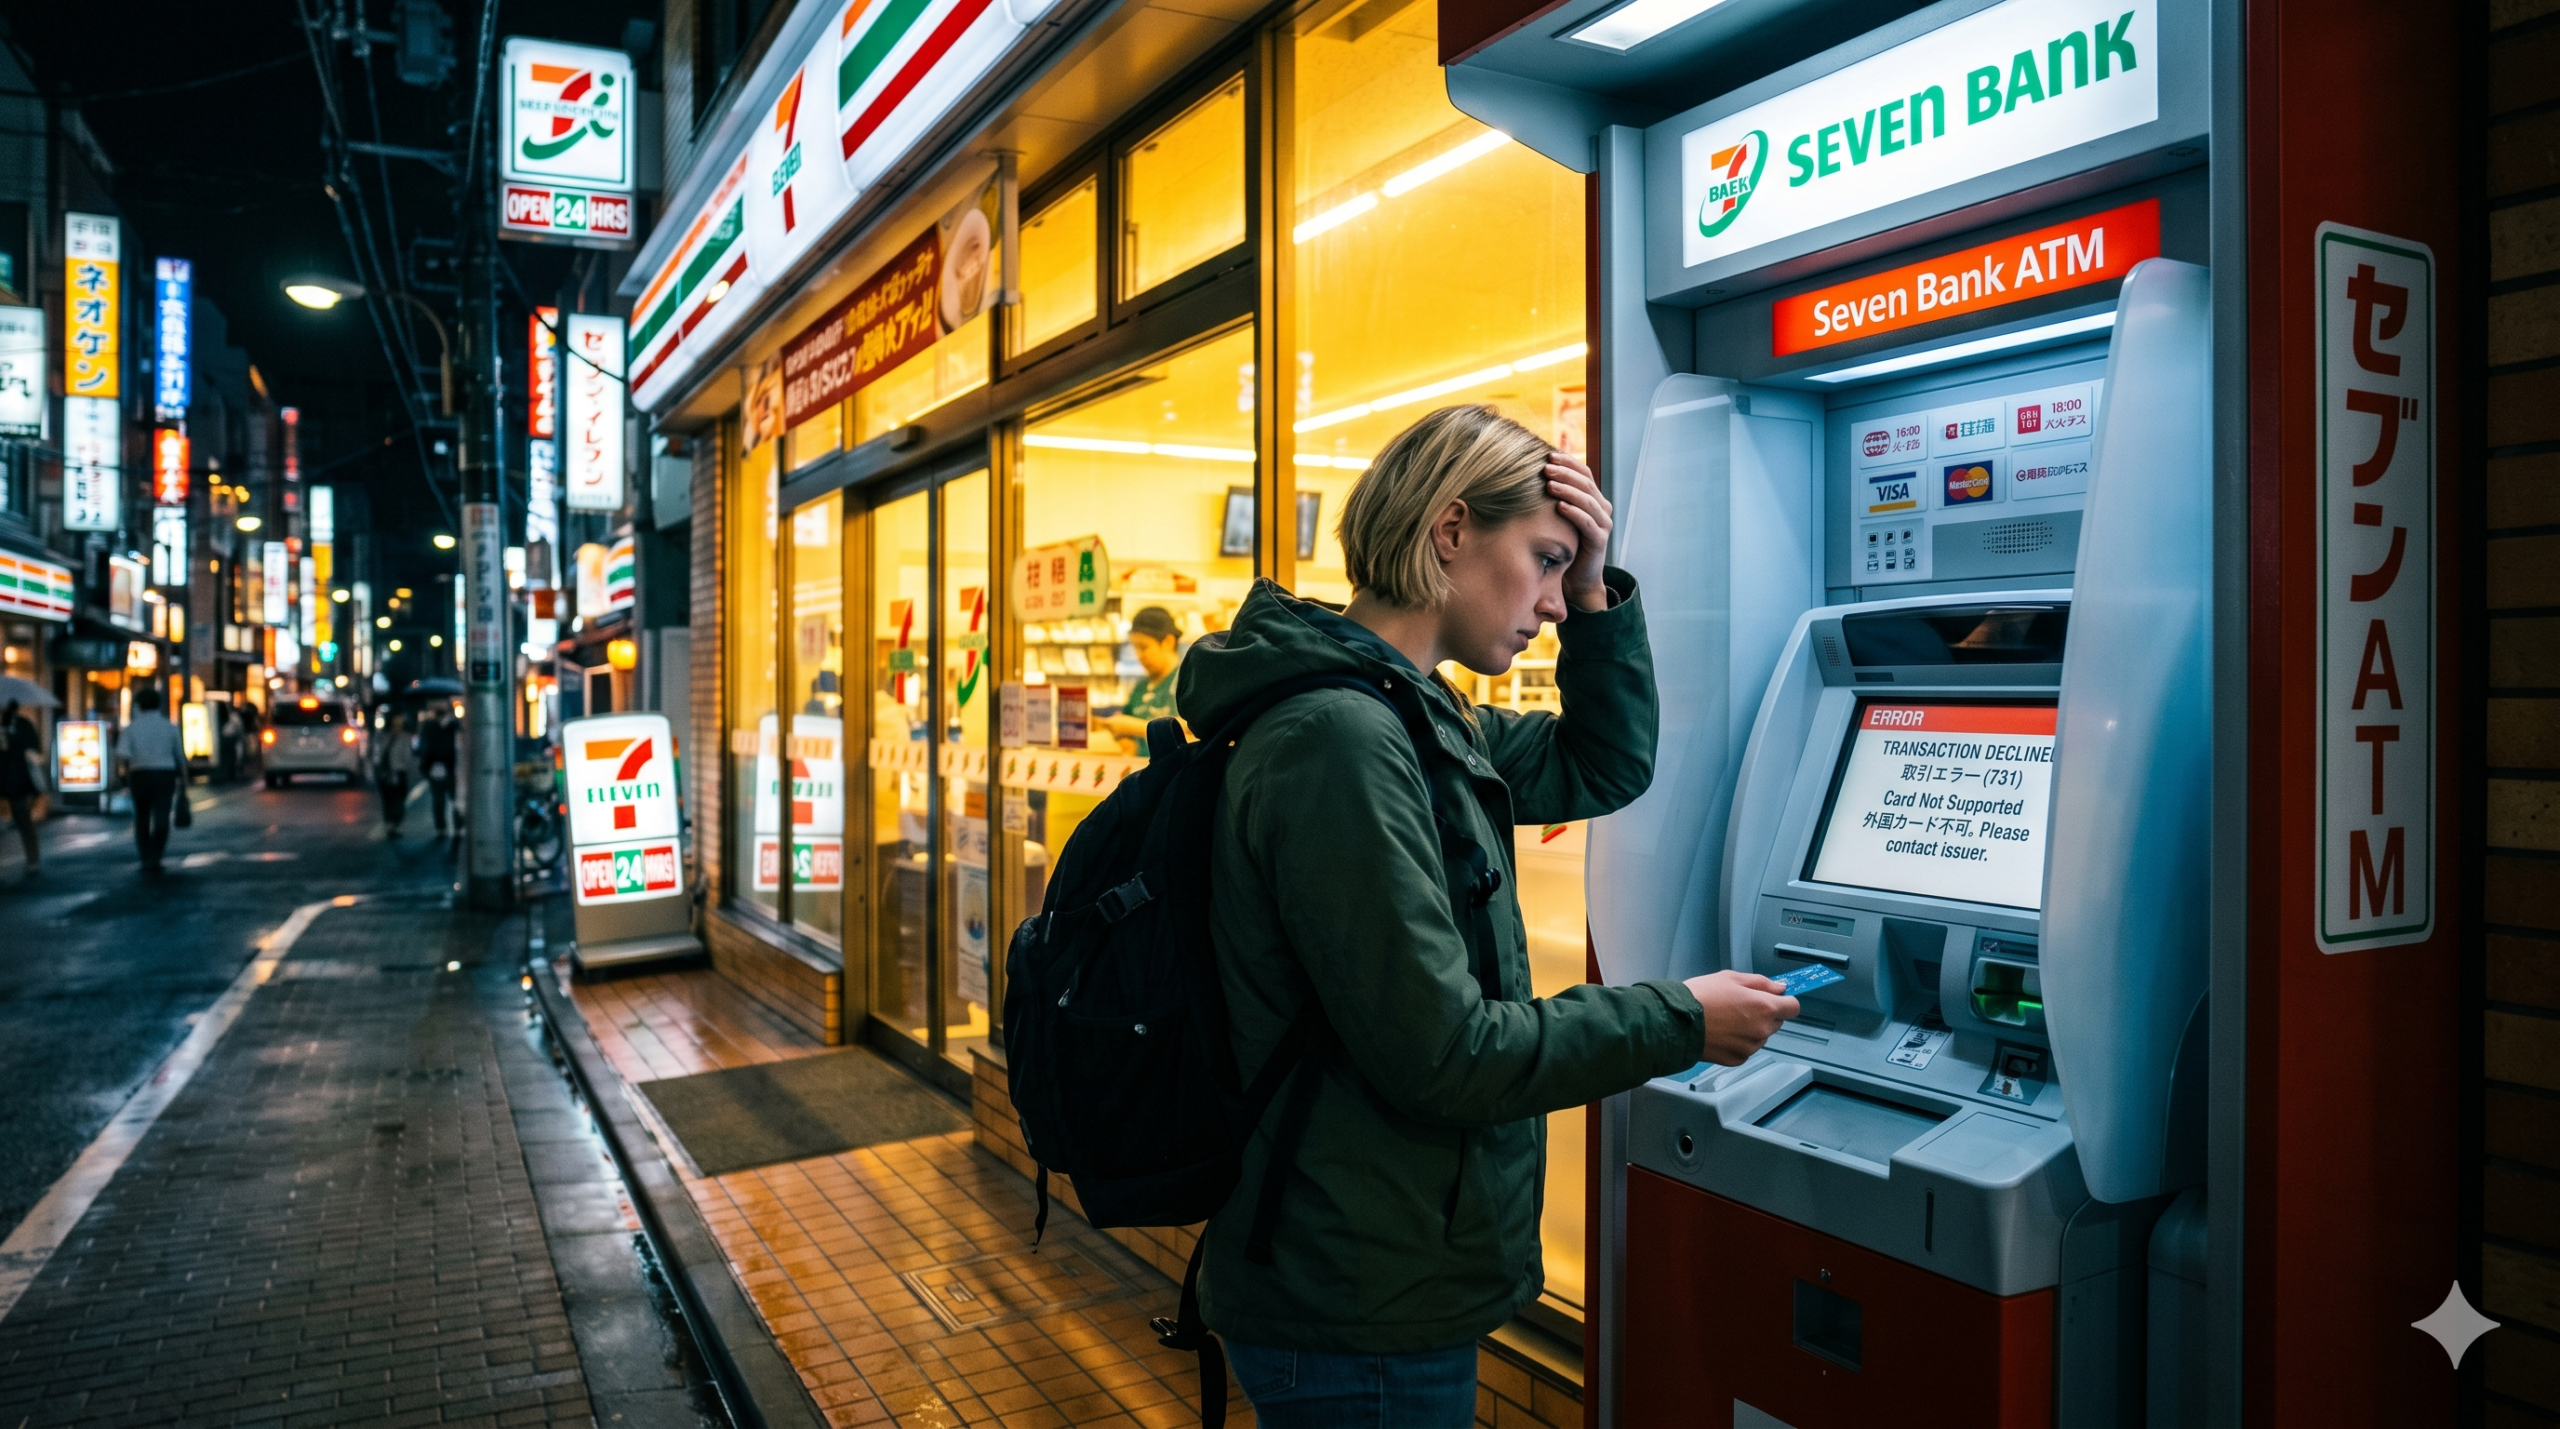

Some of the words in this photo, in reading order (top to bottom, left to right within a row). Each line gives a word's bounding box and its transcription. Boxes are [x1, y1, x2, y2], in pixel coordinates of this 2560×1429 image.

[508, 192, 550, 222] OPEN
[555, 196, 586, 227] 24
[591, 201, 627, 231] HRS
[1813, 287, 1908, 337] Seven
[1917, 255, 2006, 313] Bank
[2013, 227, 2104, 288] ATM
[76, 264, 108, 390] ネオケン
[2052, 398, 2082, 414] 18:00
[1896, 424, 1921, 439] 16:00
[1876, 482, 1909, 502] VISA
[1870, 709, 1925, 726] ERROR
[1883, 740, 1983, 760] TRANSACTION
[1985, 744, 2055, 763] DECLINE
[1900, 763, 1980, 783] 取引エラー
[1983, 768, 2023, 790] (731)
[1883, 790, 1917, 807] Card
[1919, 792, 1944, 809] Not
[1946, 794, 2024, 816] Supported
[1979, 821, 2030, 842] Please
[1885, 839, 1938, 857] contact
[1940, 841, 1988, 862] issuer.
[583, 858, 615, 891] OPEN
[616, 854, 643, 889] 24
